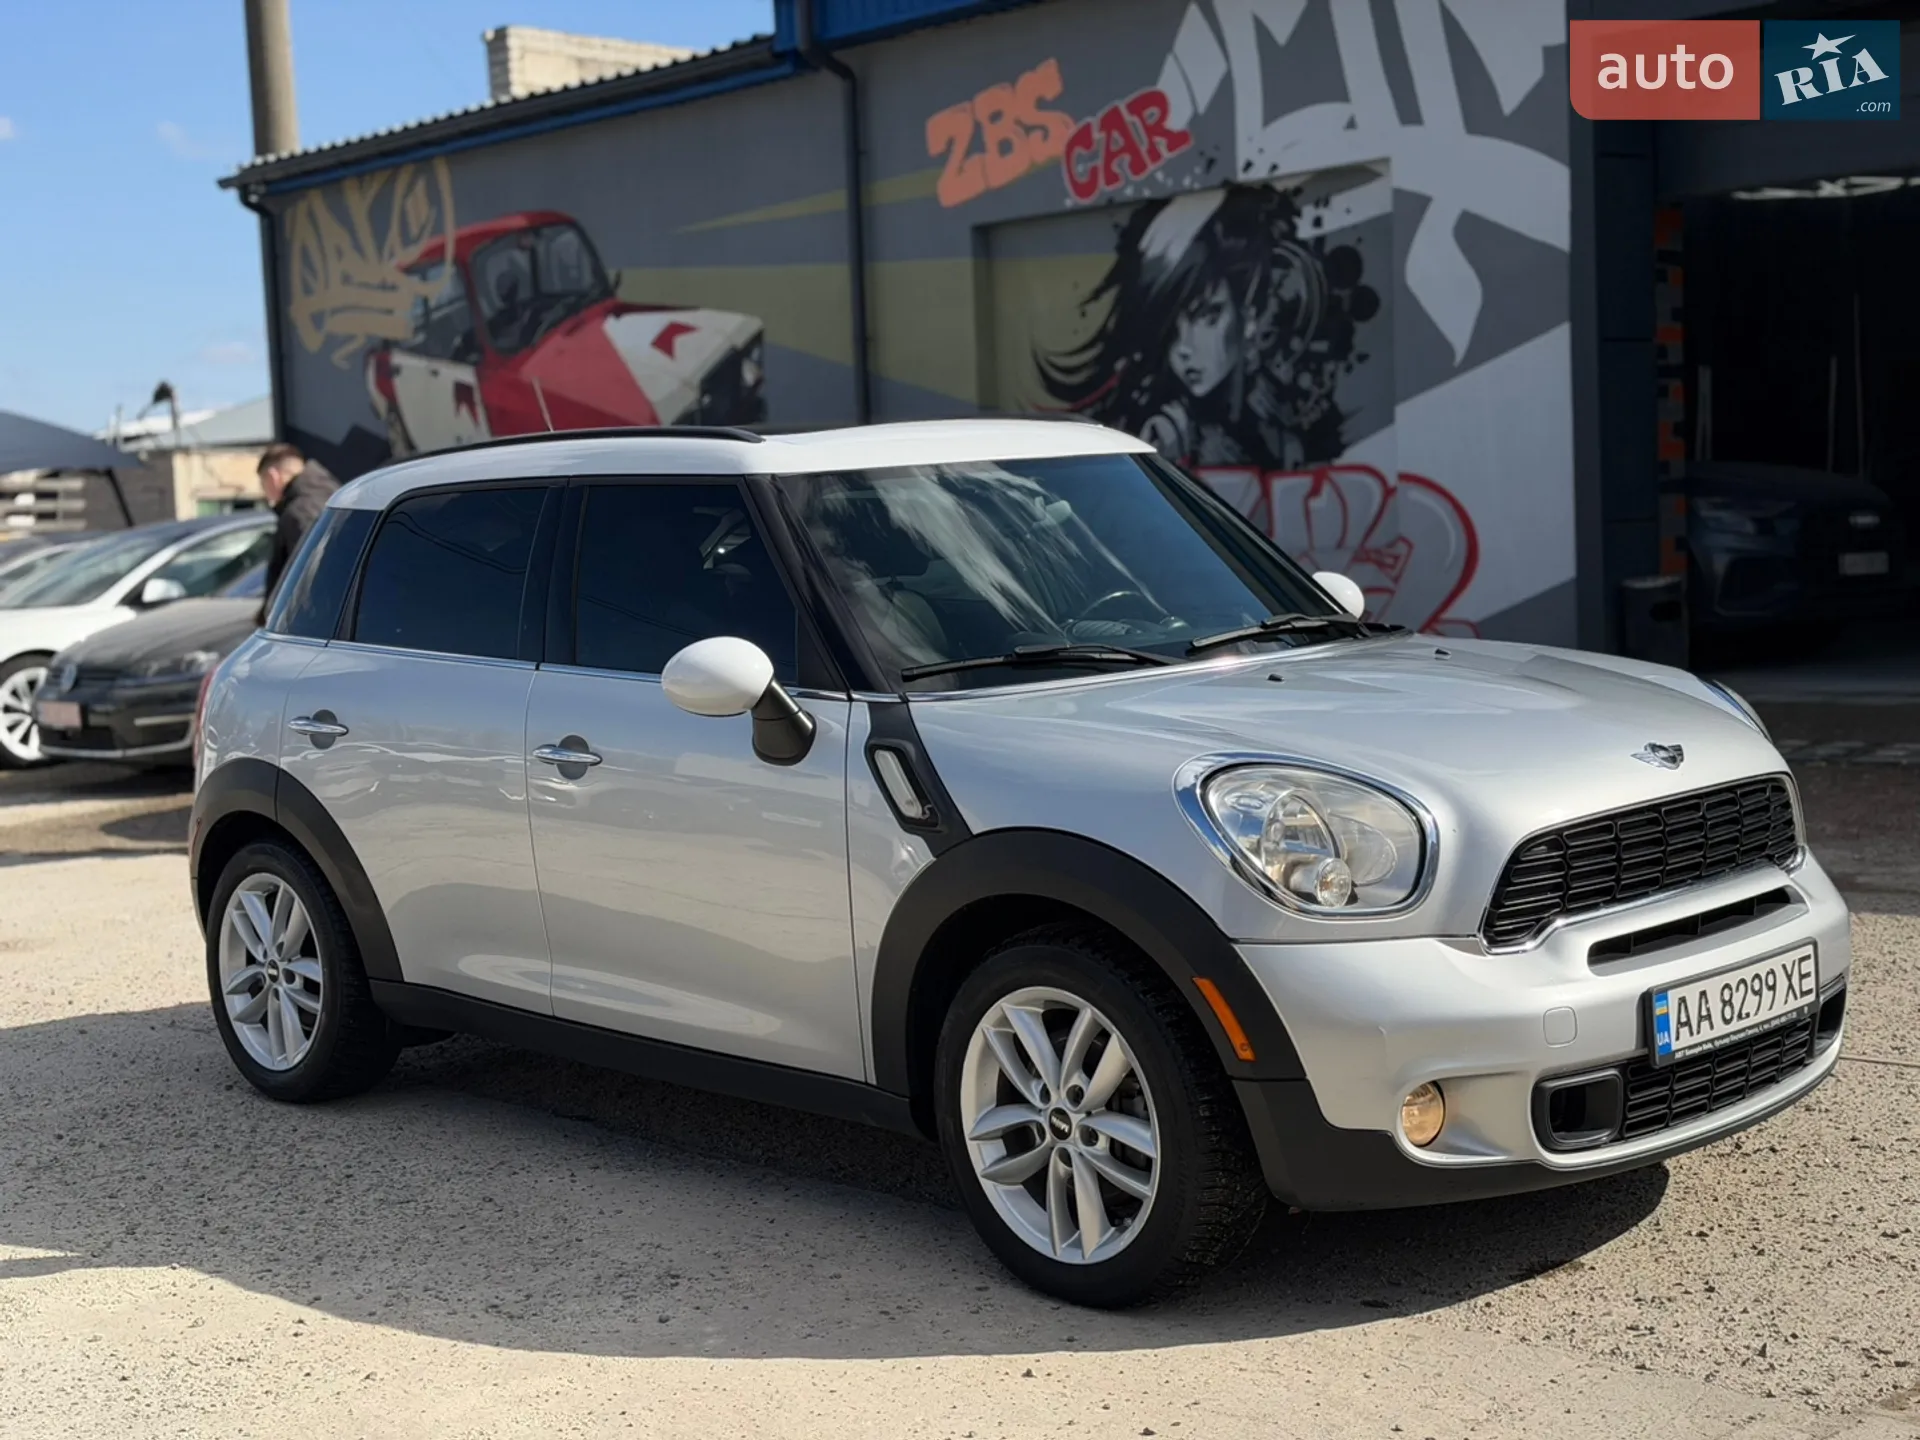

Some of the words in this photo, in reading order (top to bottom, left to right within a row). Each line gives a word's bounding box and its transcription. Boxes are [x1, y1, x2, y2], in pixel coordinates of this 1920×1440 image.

[926, 57, 1076, 208] ZBS
[1062, 86, 1194, 202] CAR
[1656, 1031, 1671, 1046] UA
[1675, 989, 1715, 1042] AA
[1720, 967, 1777, 1026] 8299
[1781, 953, 1814, 1006] XE
